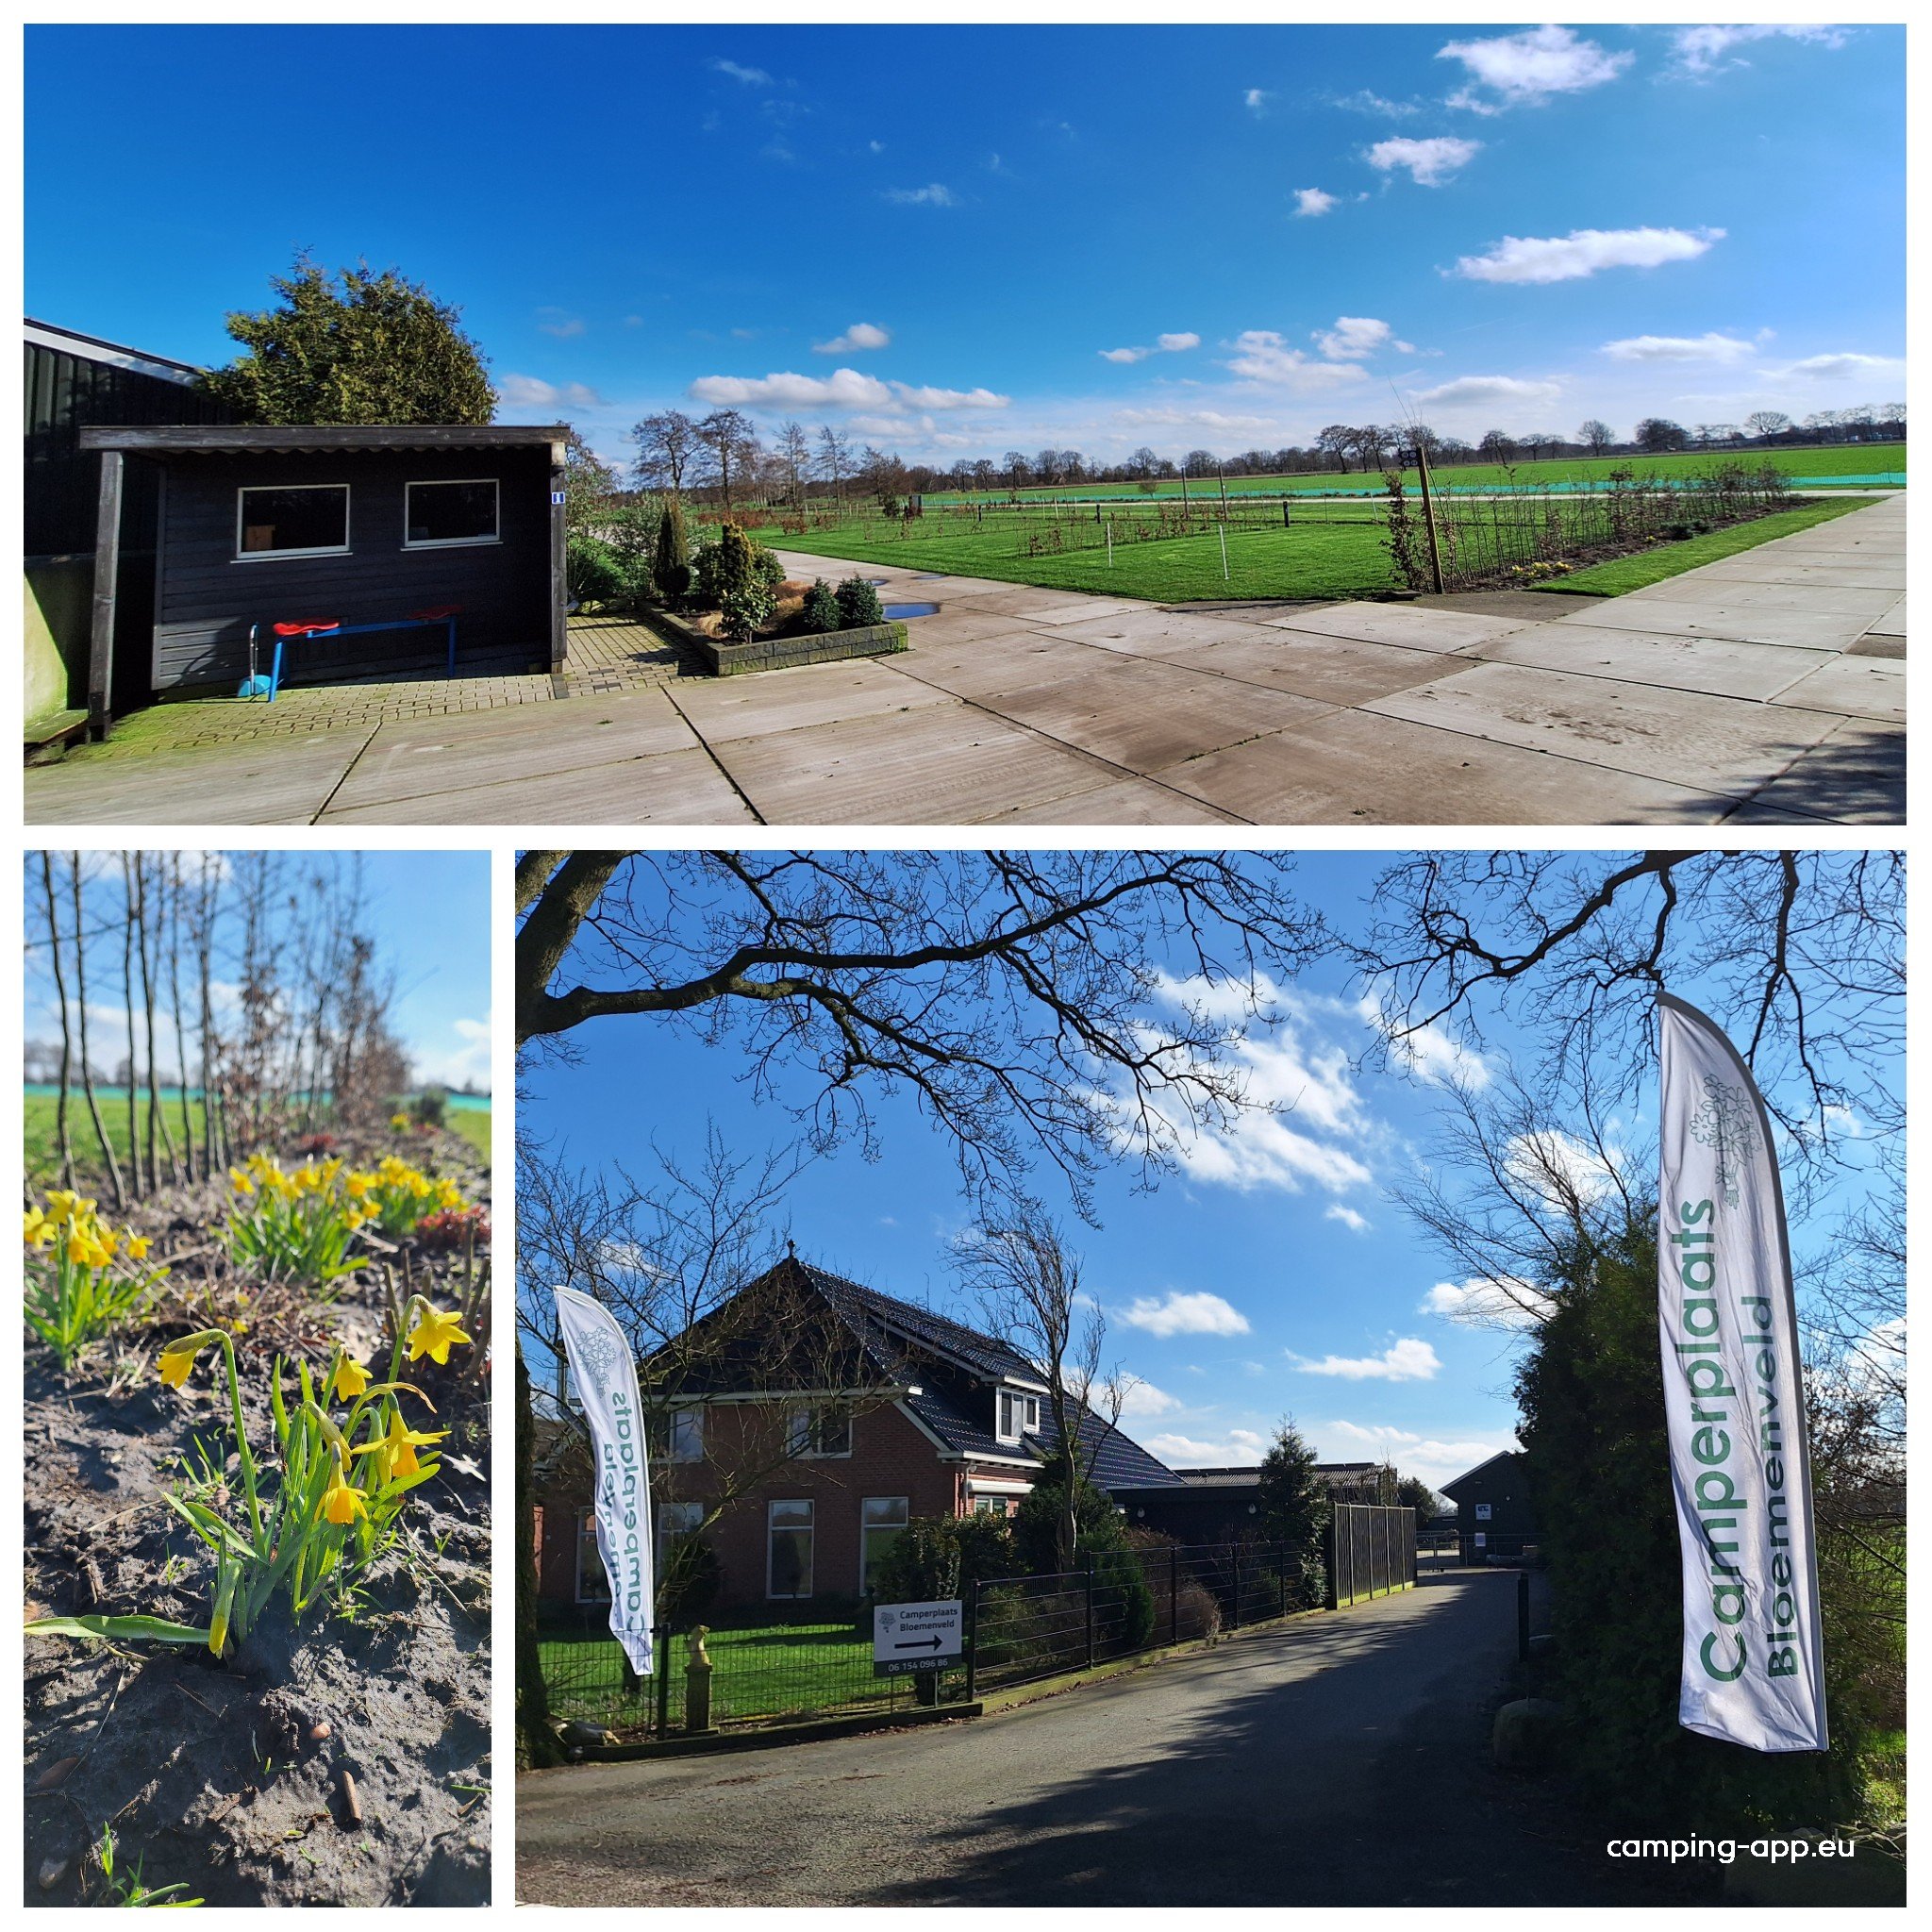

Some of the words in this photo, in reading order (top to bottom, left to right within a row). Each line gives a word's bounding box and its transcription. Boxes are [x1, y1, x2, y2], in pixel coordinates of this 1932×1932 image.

[1672, 1198, 1748, 1683] Camperplaats
[1741, 1295, 1798, 1679] Bloemenveld
[899, 1607, 958, 1620] Camperplaats
[899, 1620, 955, 1631] Bloemenveld
[888, 1663, 900, 1673] 06
[902, 1661, 918, 1671] 154
